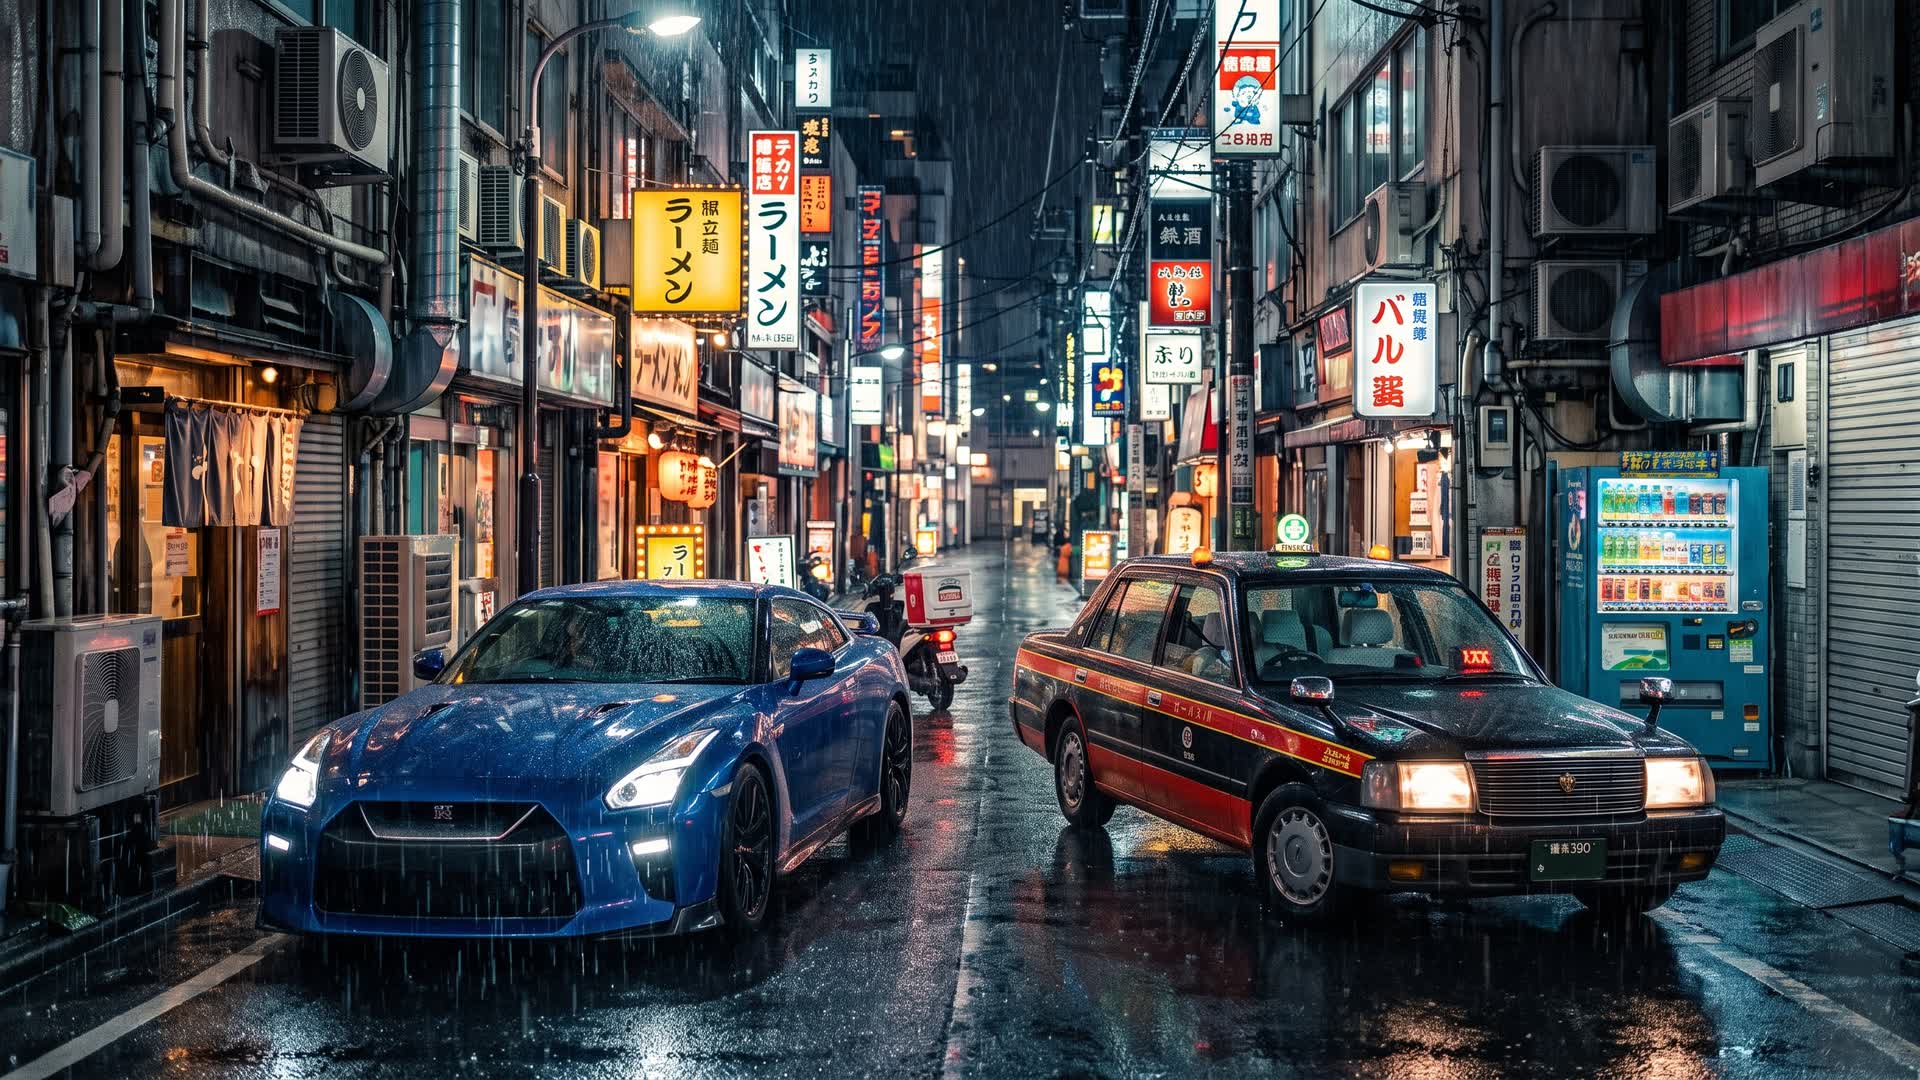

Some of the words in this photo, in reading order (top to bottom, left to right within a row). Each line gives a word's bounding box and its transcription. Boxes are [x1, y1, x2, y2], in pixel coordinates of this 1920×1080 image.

[664, 198, 692, 304] ラーメン
[757, 201, 787, 326] ラーメン
